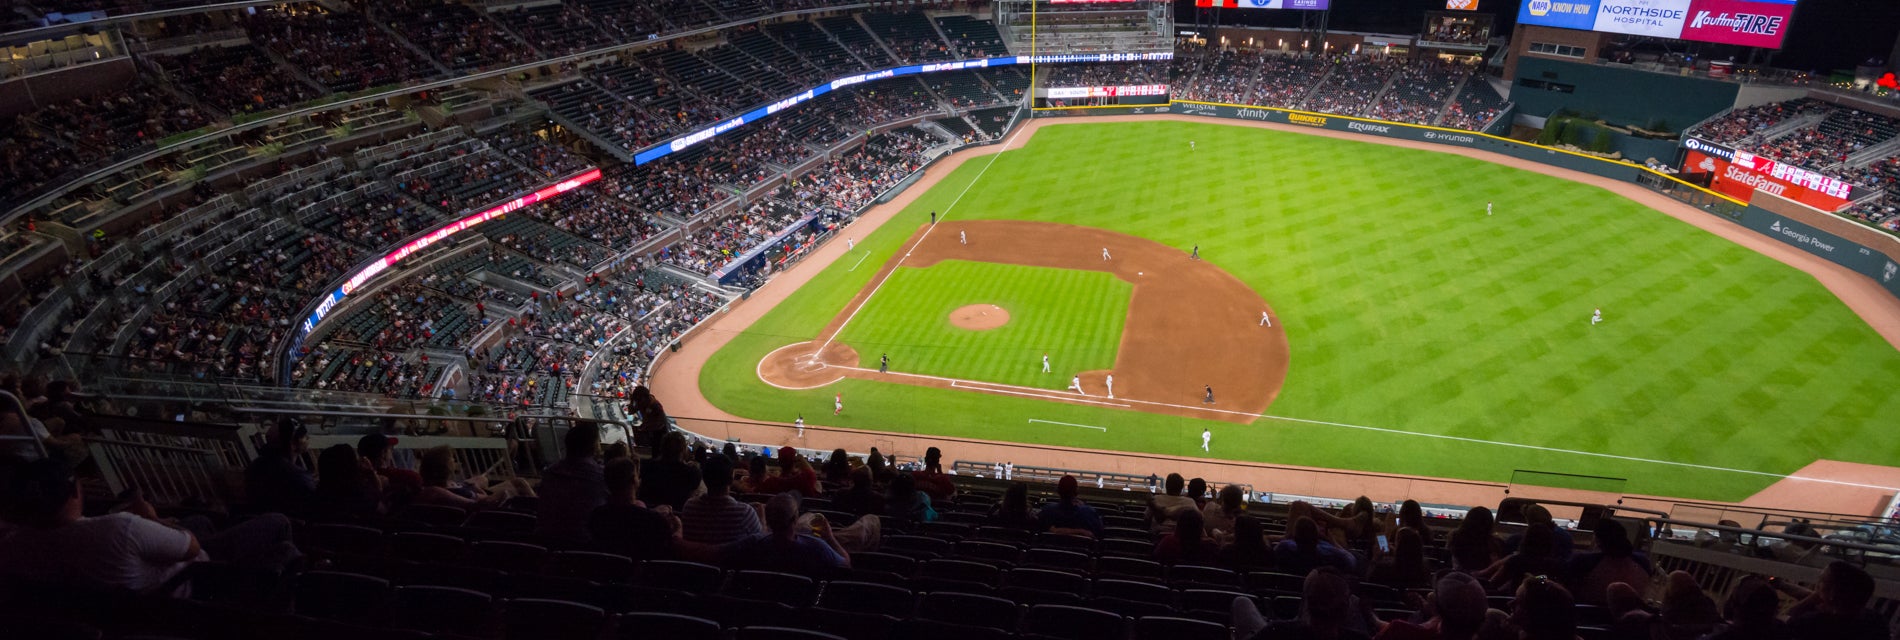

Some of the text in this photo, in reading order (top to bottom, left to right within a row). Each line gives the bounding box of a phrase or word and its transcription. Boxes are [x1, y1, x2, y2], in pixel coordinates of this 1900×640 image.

[1532, 1, 1548, 11] NAPA
[1552, 2, 1573, 14] KNOW
[1573, 4, 1591, 15] HOW
[1602, 4, 1684, 20] NORTHSIDE
[1613, 16, 1664, 27] HOSPITAL
[1690, 10, 1783, 36] Kauffman TIRE
[1236, 107, 1270, 121] xfinity
[1288, 112, 1327, 124] QUIKRETE
[1347, 121, 1391, 134] EQUIFAX
[1437, 133, 1474, 144] HYUNDAI
[1782, 226, 1835, 253] Georgia Power
